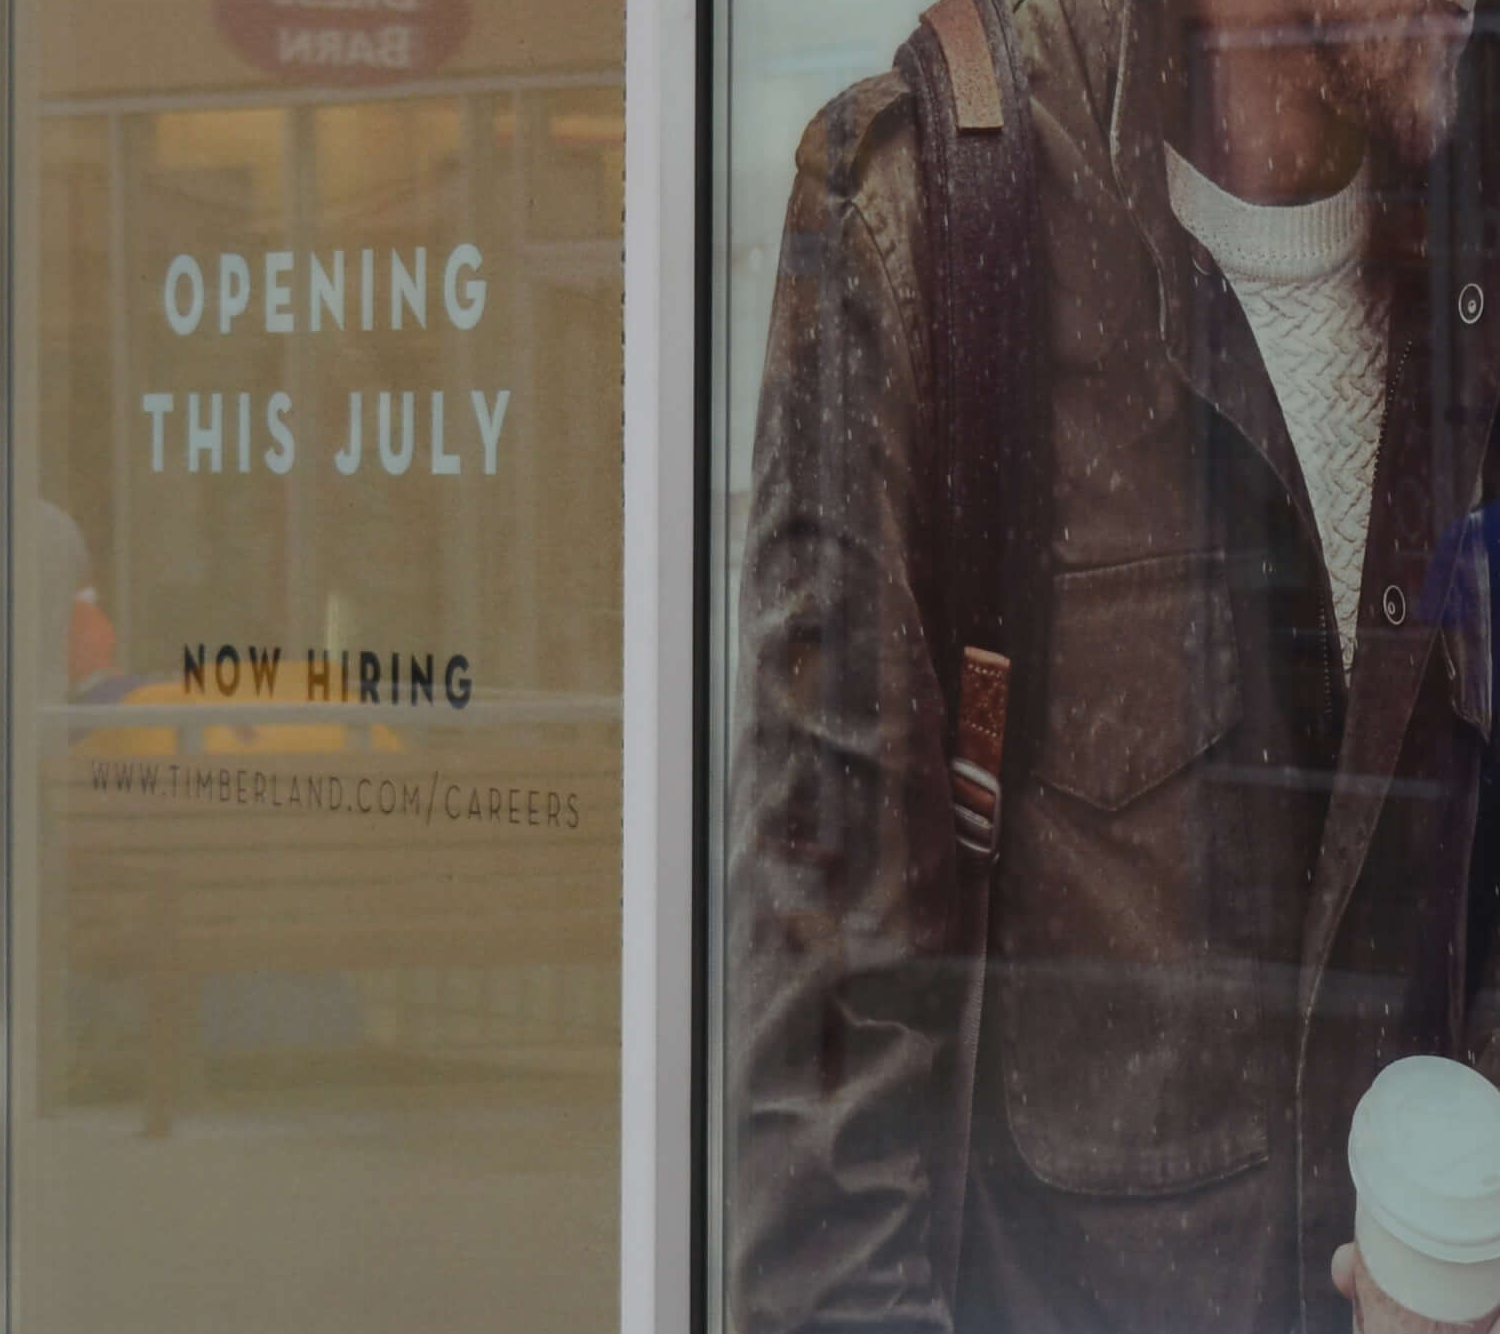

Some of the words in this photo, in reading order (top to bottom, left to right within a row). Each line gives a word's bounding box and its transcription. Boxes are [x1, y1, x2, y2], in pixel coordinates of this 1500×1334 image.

[164, 243, 488, 336] OPENING
[142, 392, 296, 475] THIS
[334, 390, 511, 475] JULY
[182, 643, 282, 698] NOW
[306, 647, 473, 709] HIRING
[91, 759, 580, 830] WWW.TIMBERLAND.COM/CAREERS
